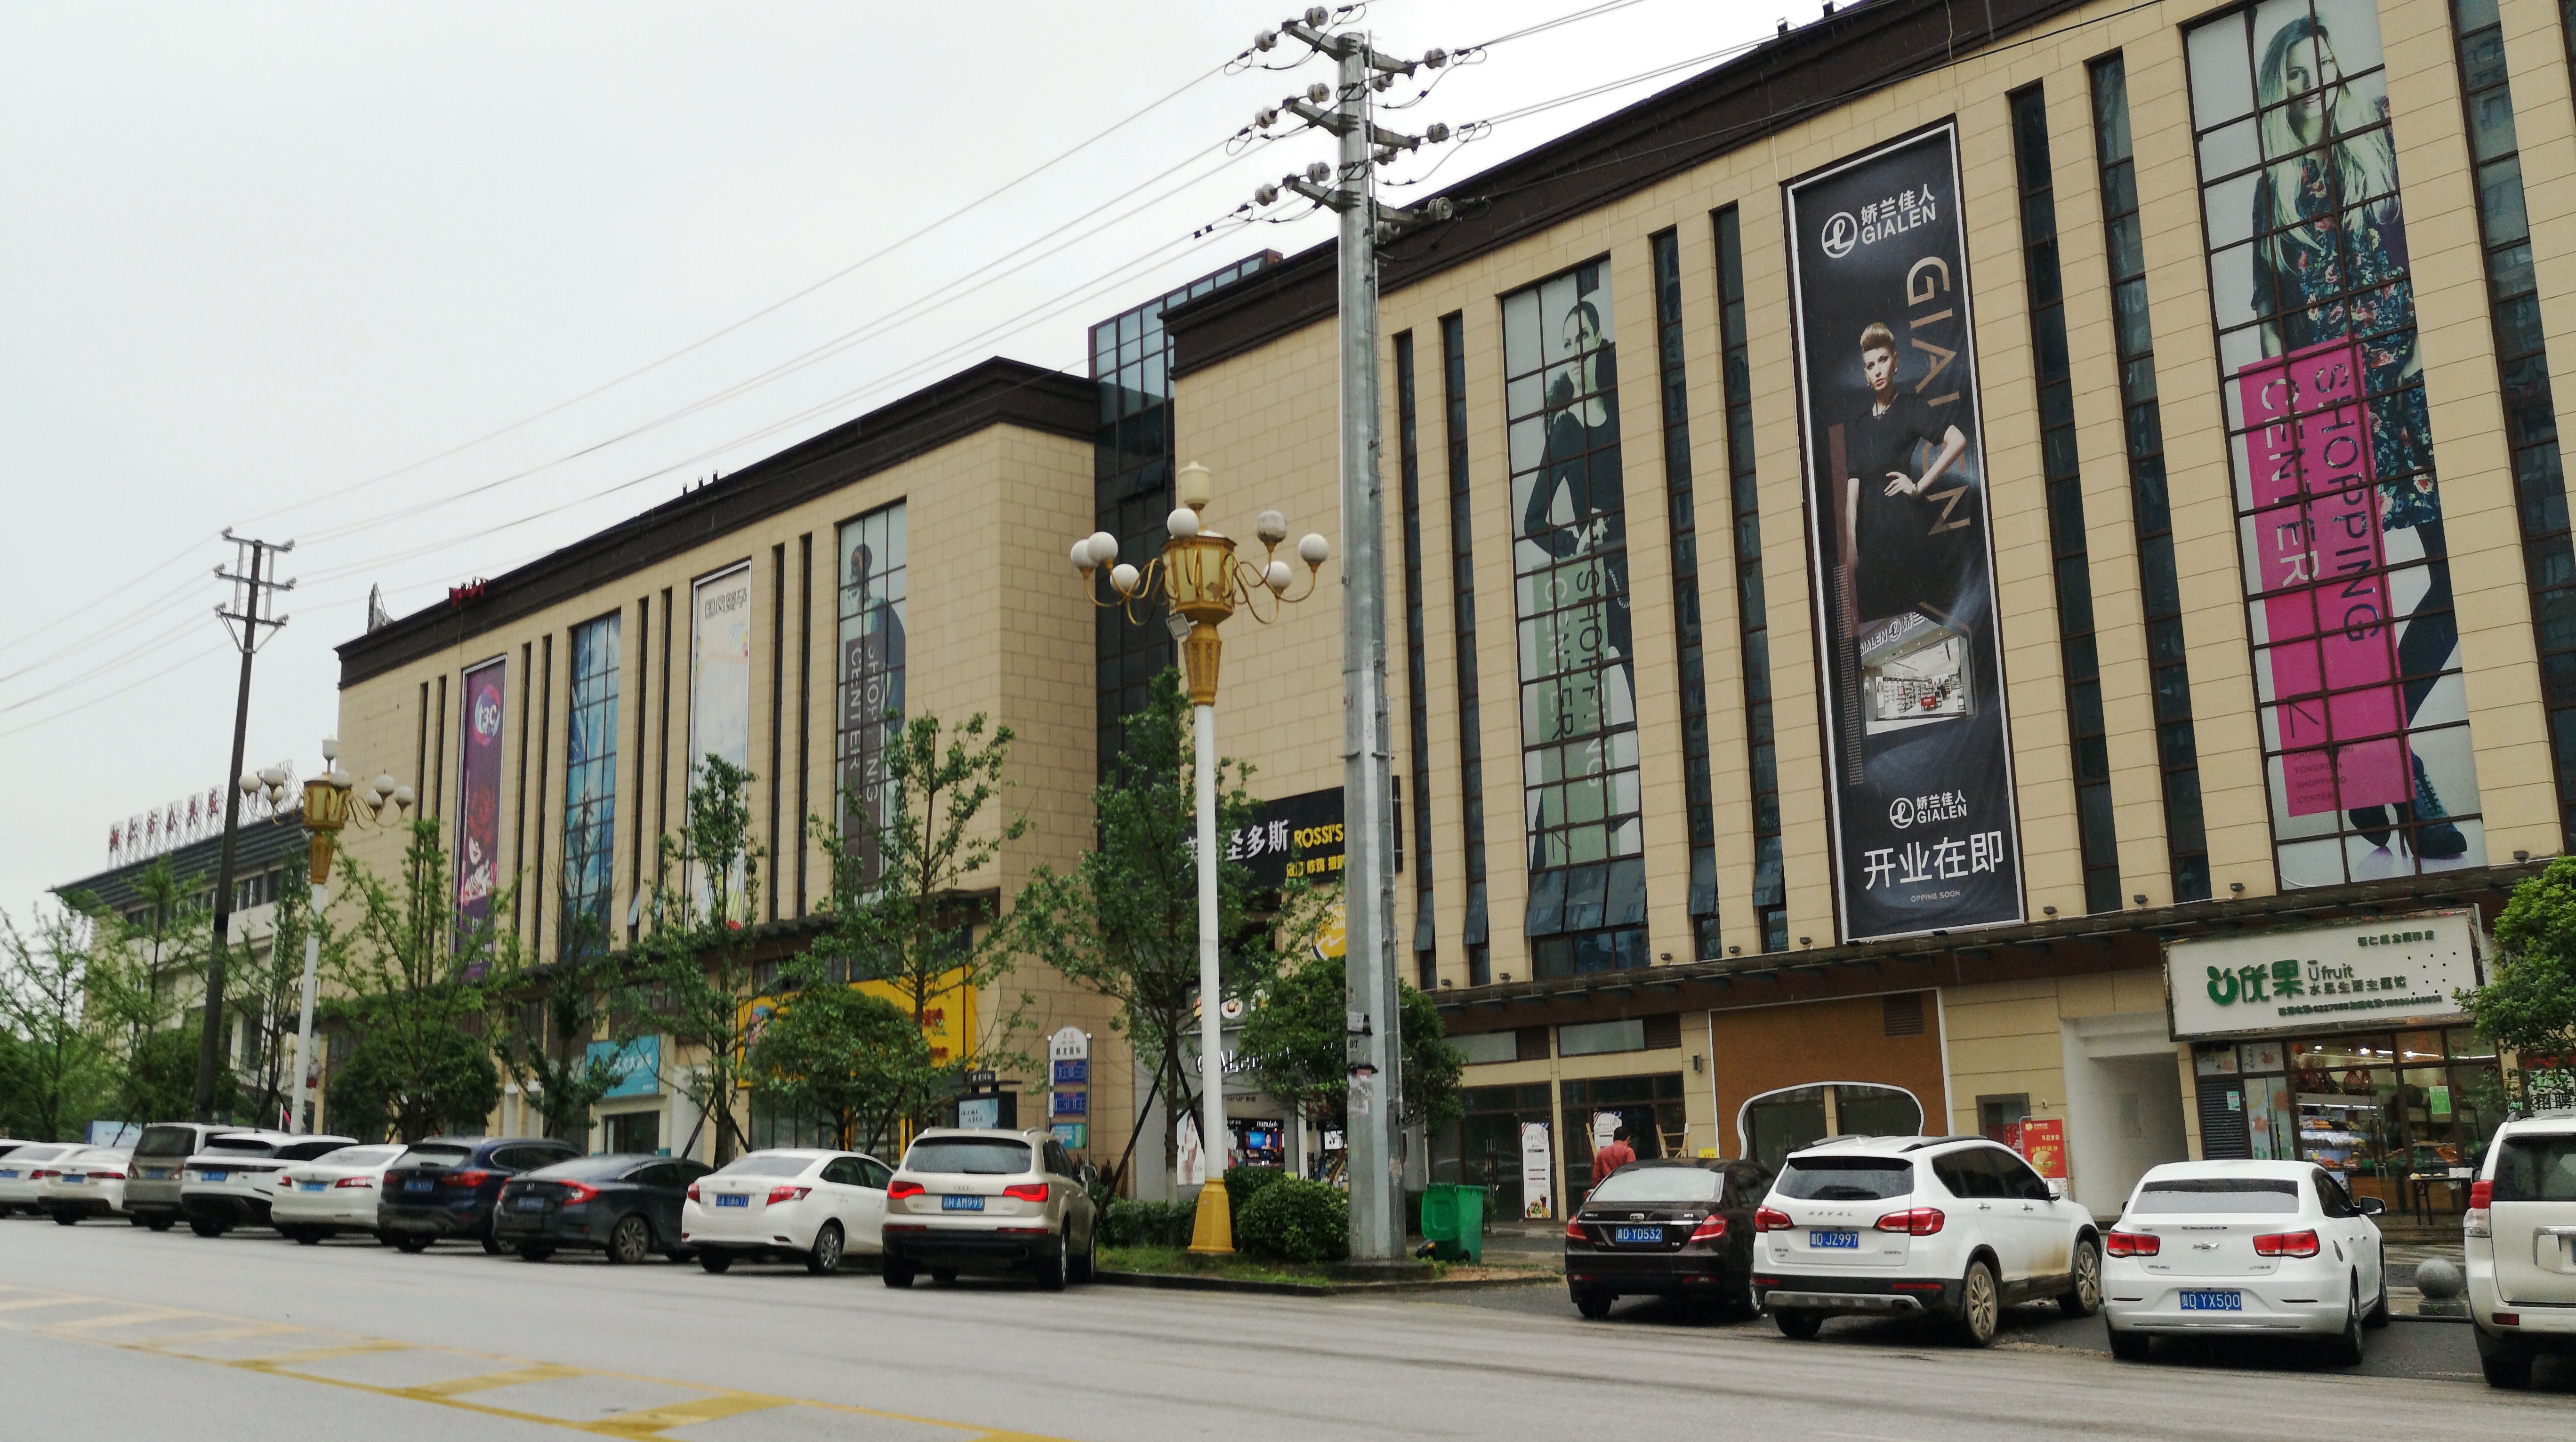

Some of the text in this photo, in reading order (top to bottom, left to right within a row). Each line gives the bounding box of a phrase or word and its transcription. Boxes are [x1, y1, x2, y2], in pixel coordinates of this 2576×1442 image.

[1860, 183, 1935, 225] 娇兰佳人
[1862, 202, 1936, 244] GIALEN
[2260, 377, 2320, 588] CENTER
[2314, 362, 2380, 643] SHOPPING
[1902, 612, 1928, 632] 娇兰
[1916, 790, 1966, 810] 娇兰佳人
[1917, 804, 1967, 824] GIALEN
[1864, 830, 2004, 890] 开业在即
[1940, 890, 1960, 899] SOON
